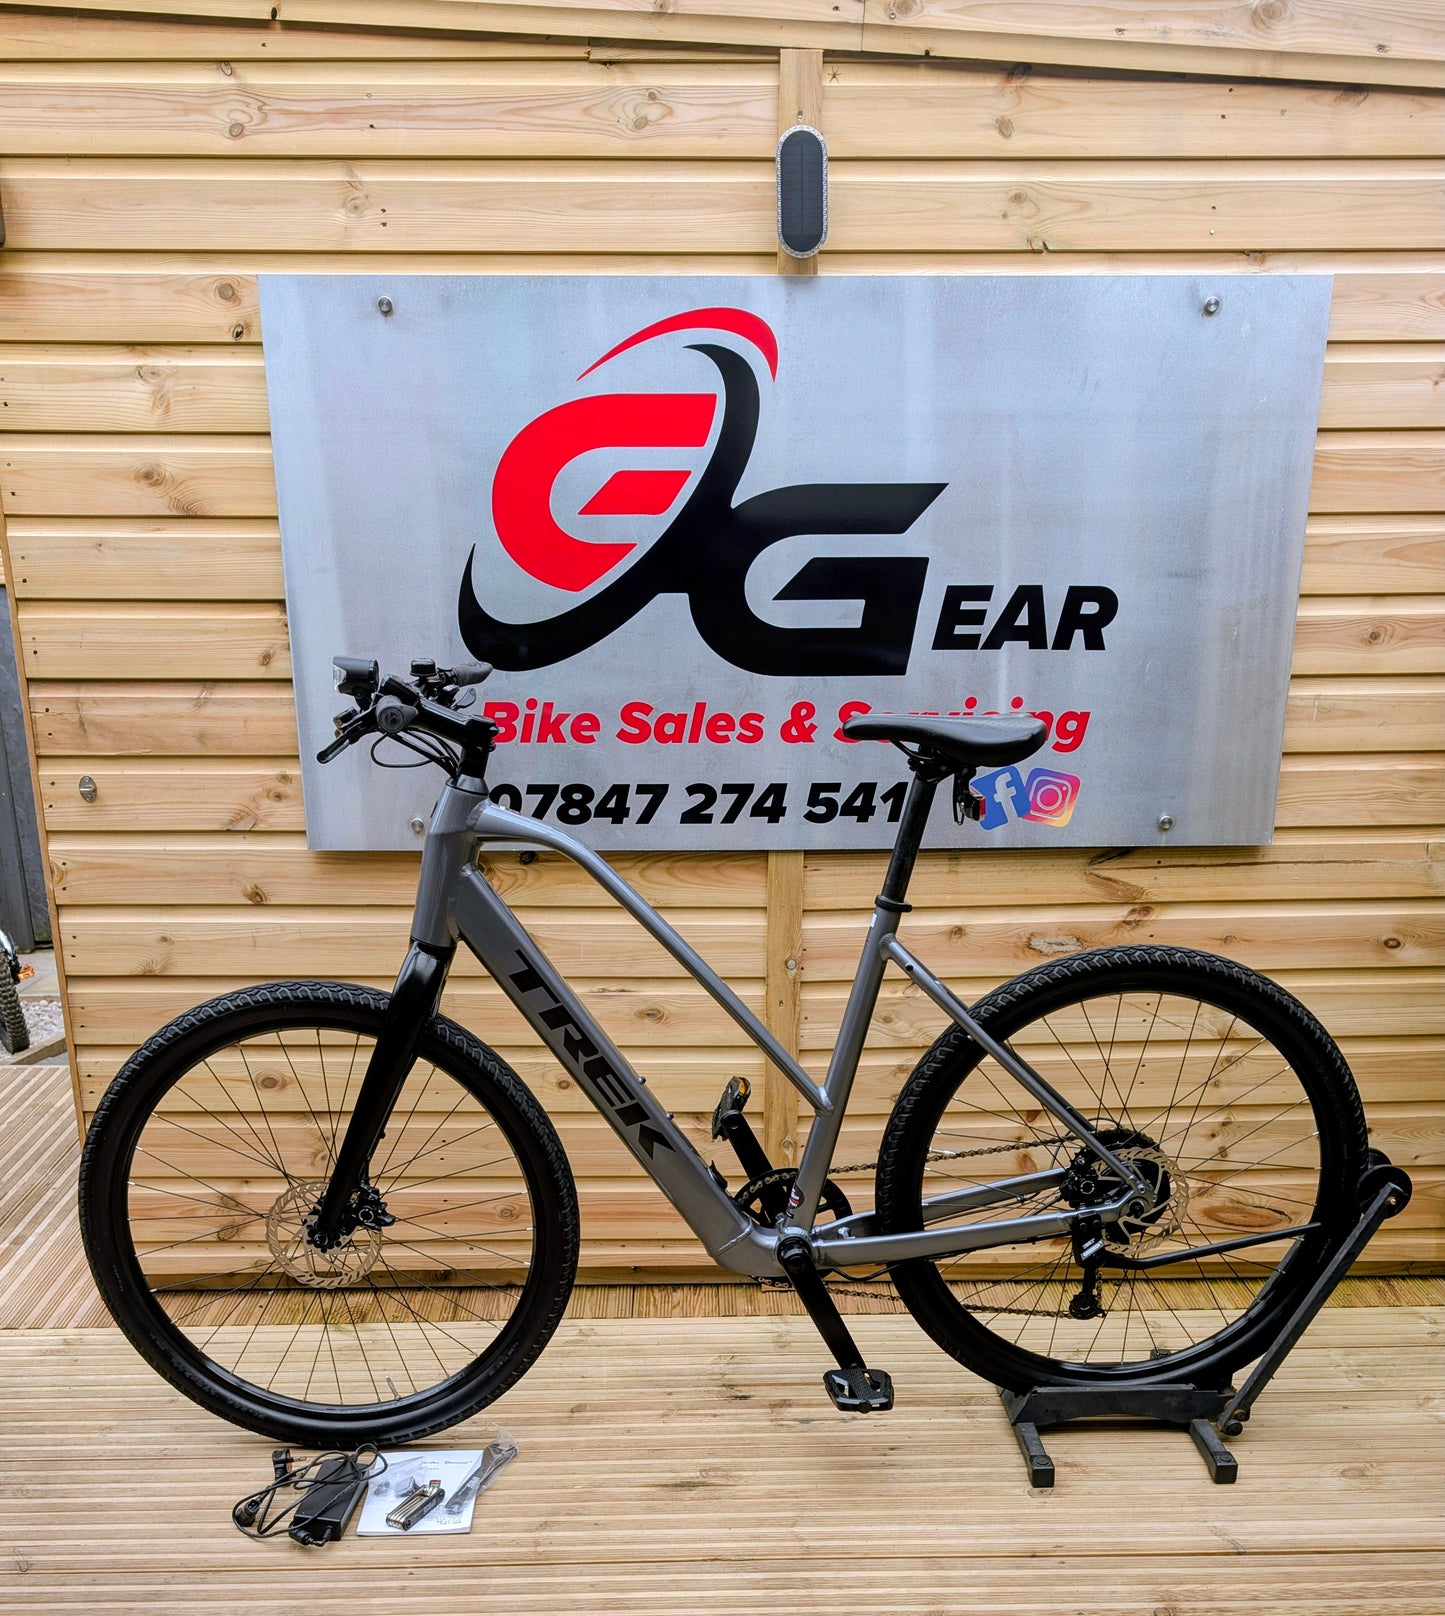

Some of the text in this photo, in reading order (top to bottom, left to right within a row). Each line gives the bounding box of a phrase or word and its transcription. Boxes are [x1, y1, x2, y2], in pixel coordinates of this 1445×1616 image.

[483, 697, 602, 745] Bike
[616, 700, 765, 745] Sales
[780, 701, 818, 744] &
[488, 782, 909, 825] 07847 274 541
[508, 949, 676, 1160] TREK
